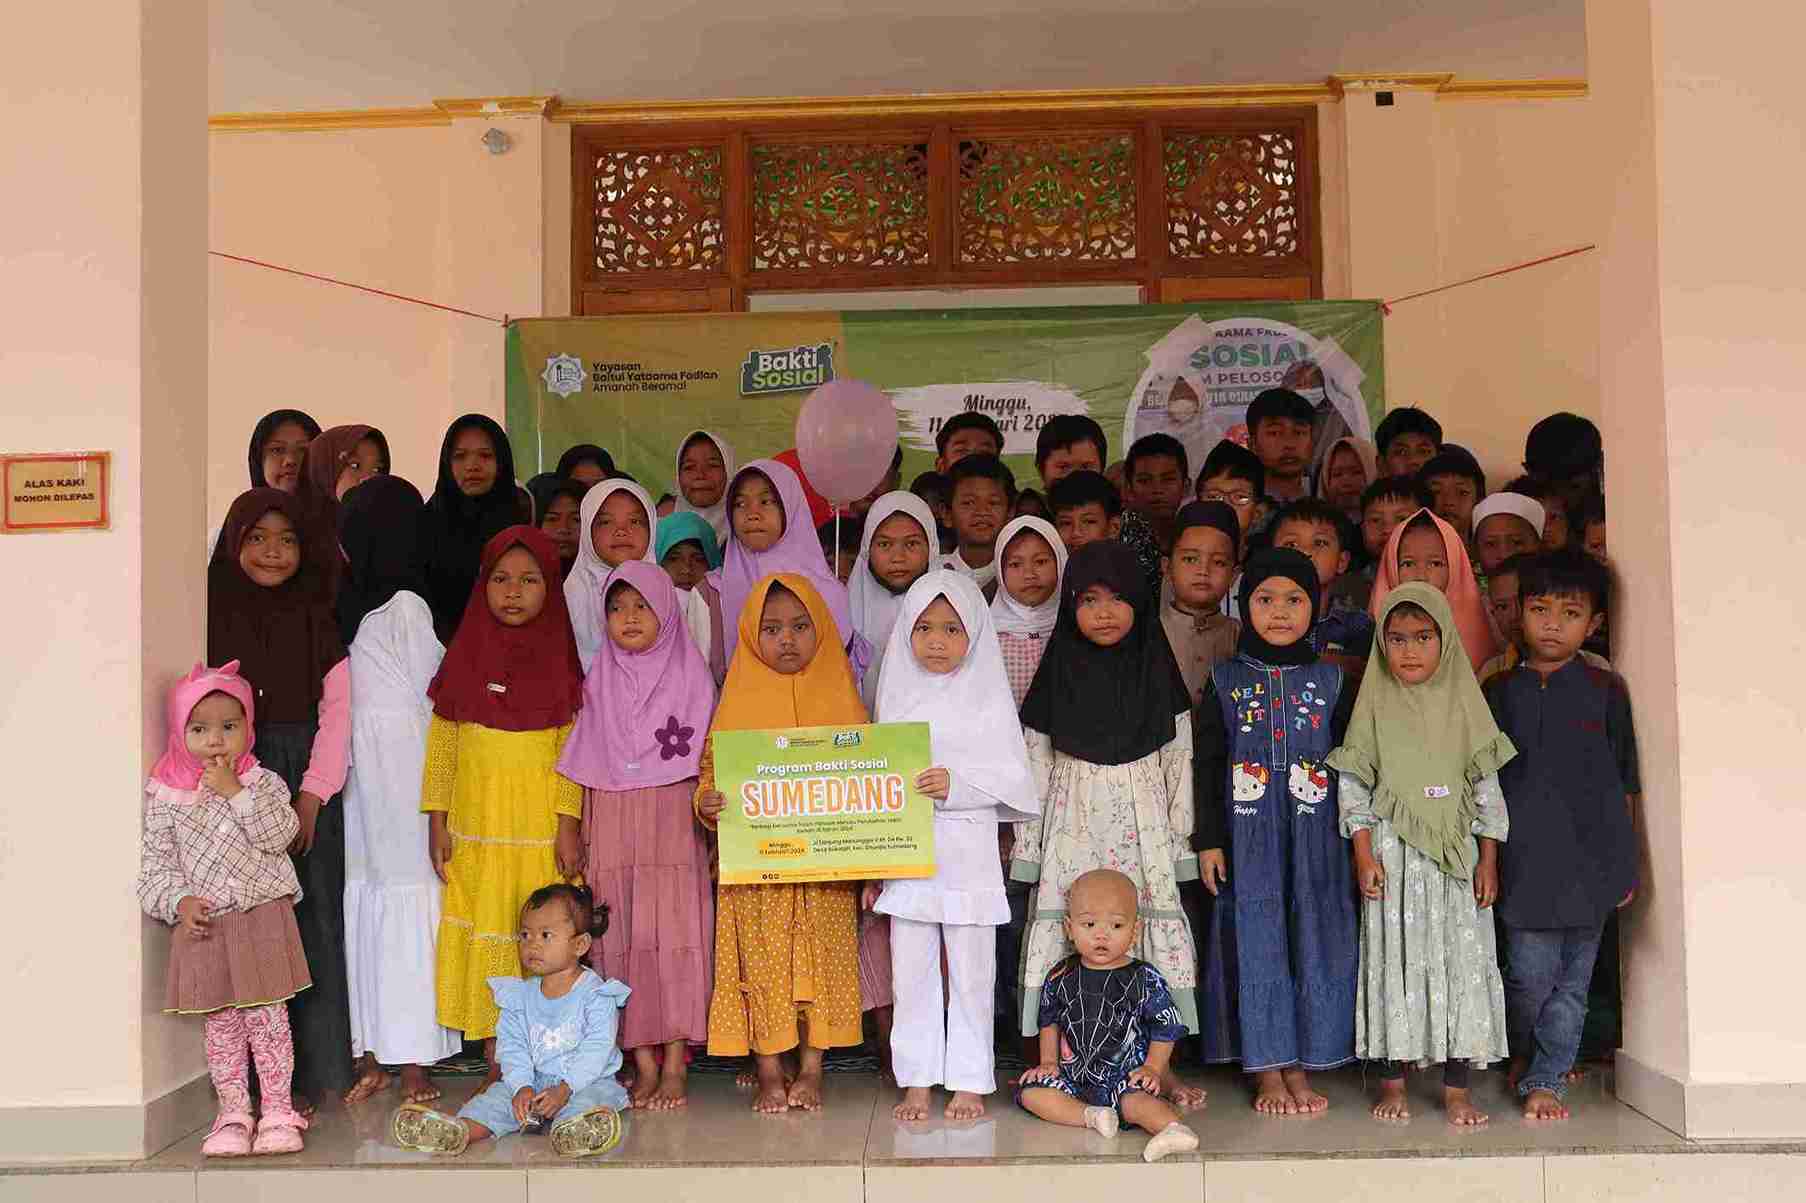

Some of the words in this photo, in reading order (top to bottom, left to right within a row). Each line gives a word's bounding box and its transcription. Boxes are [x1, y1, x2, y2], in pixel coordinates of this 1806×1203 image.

[592, 362, 641, 373] Yayasan
[759, 350, 817, 371] Bakti
[592, 371, 625, 382] Baitul
[752, 364, 824, 389] Sosial
[1218, 371, 1283, 385] PELOSO
[592, 382, 639, 393] Amanah
[640, 381, 688, 392] Beramal
[963, 393, 1032, 416] Minggu,
[1023, 414, 1057, 431] 20
[24, 479, 54, 489] ALAS
[56, 478, 86, 488] KAKI
[14, 494, 51, 503] MOHON
[54, 492, 95, 502] DILEPAS
[757, 761, 812, 777] Program
[815, 759, 848, 773] Bakti
[851, 757, 888, 770] Sosial
[742, 774, 904, 817] SUMEDANG
